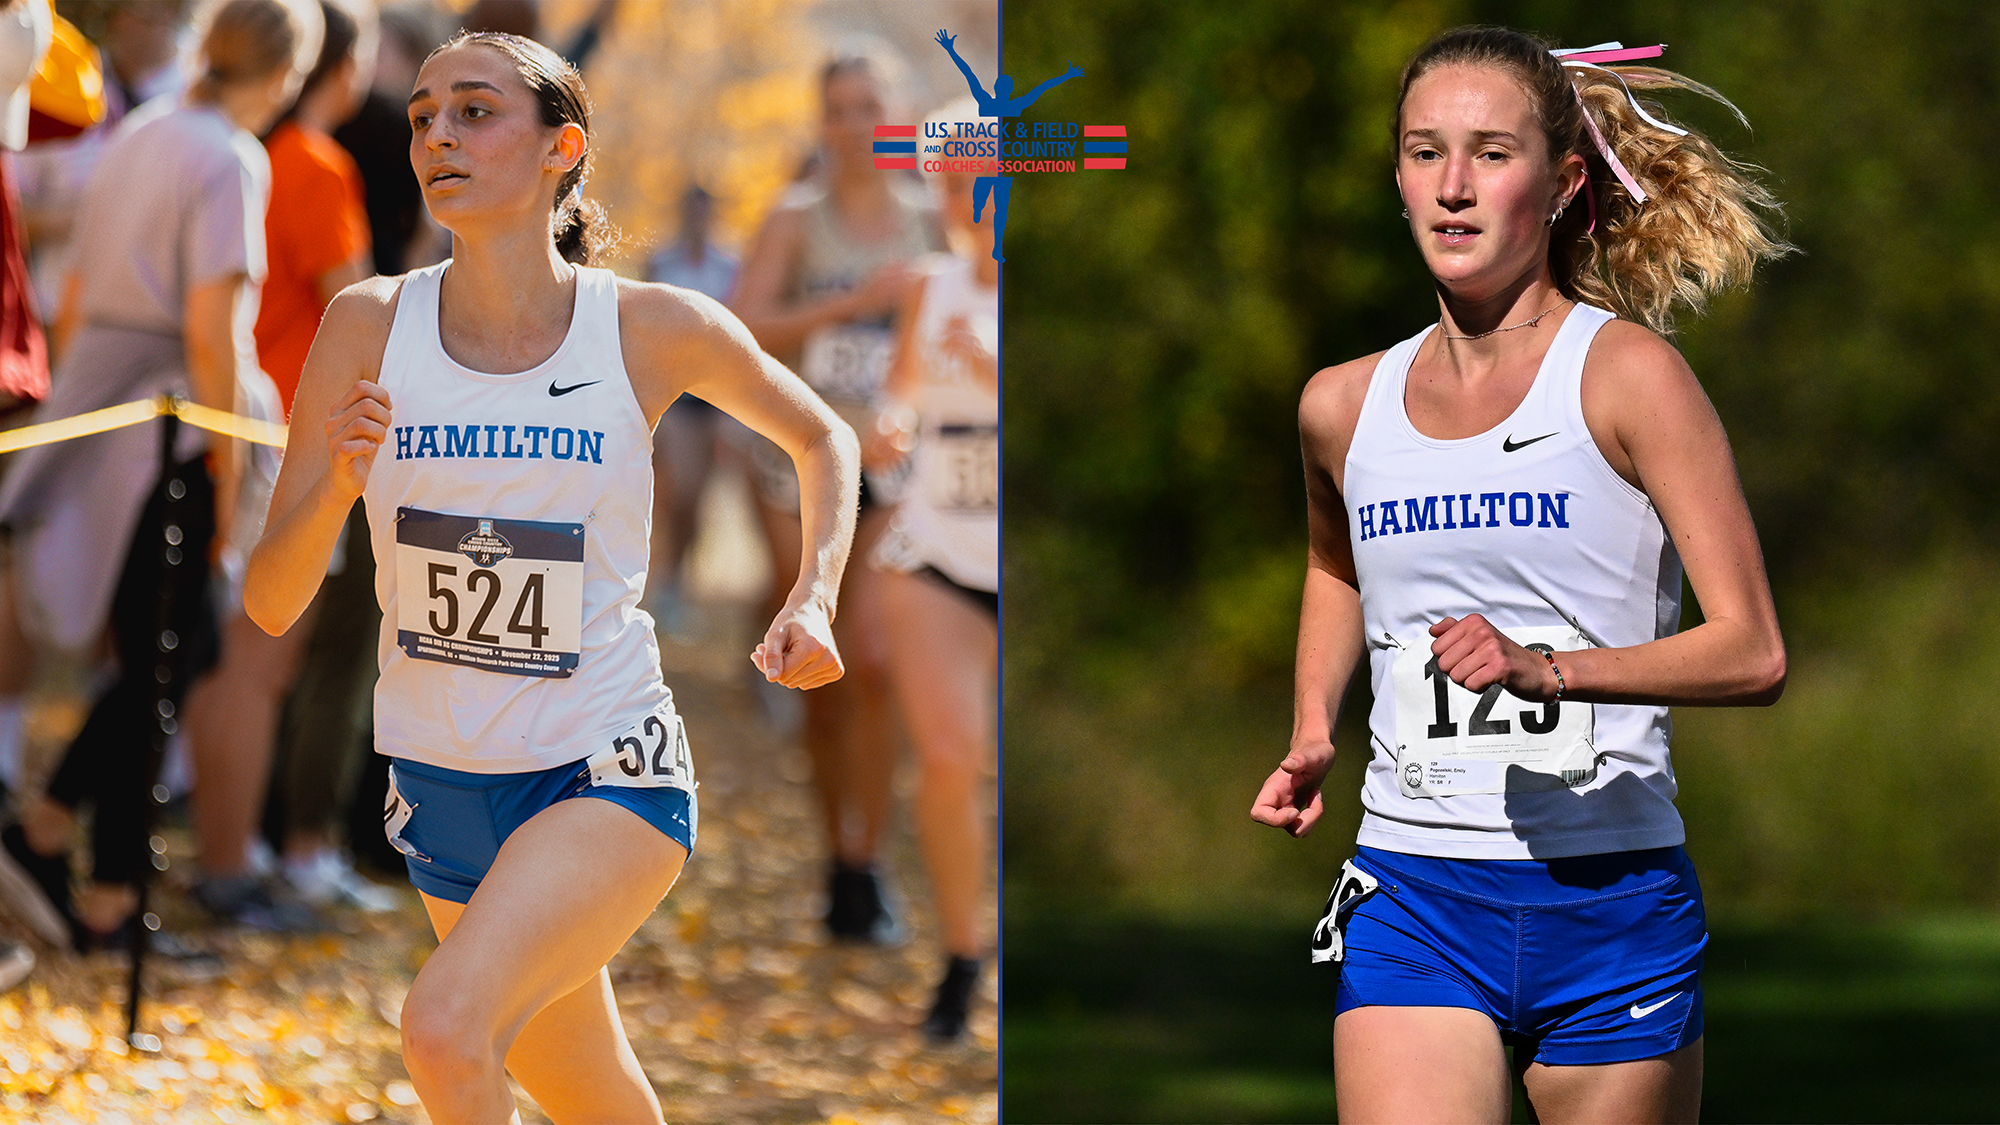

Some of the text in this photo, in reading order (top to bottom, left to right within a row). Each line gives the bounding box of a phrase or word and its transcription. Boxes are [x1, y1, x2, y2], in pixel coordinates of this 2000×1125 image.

[395, 425, 605, 465] HAMILTON
[1358, 491, 1570, 542] HAMILTON
[460, 543, 511, 555] CHAMPIONSHIPS
[427, 562, 550, 649] 524
[451, 642, 493, 656] CHAMPIONSHIPS
[501, 650, 531, 660] November
[532, 653, 543, 661] 22,
[544, 654, 560, 662] 2025
[510, 660, 524, 669] Cross
[525, 662, 543, 671] Country
[544, 664, 560, 672] Course
[612, 715, 689, 781] 524
